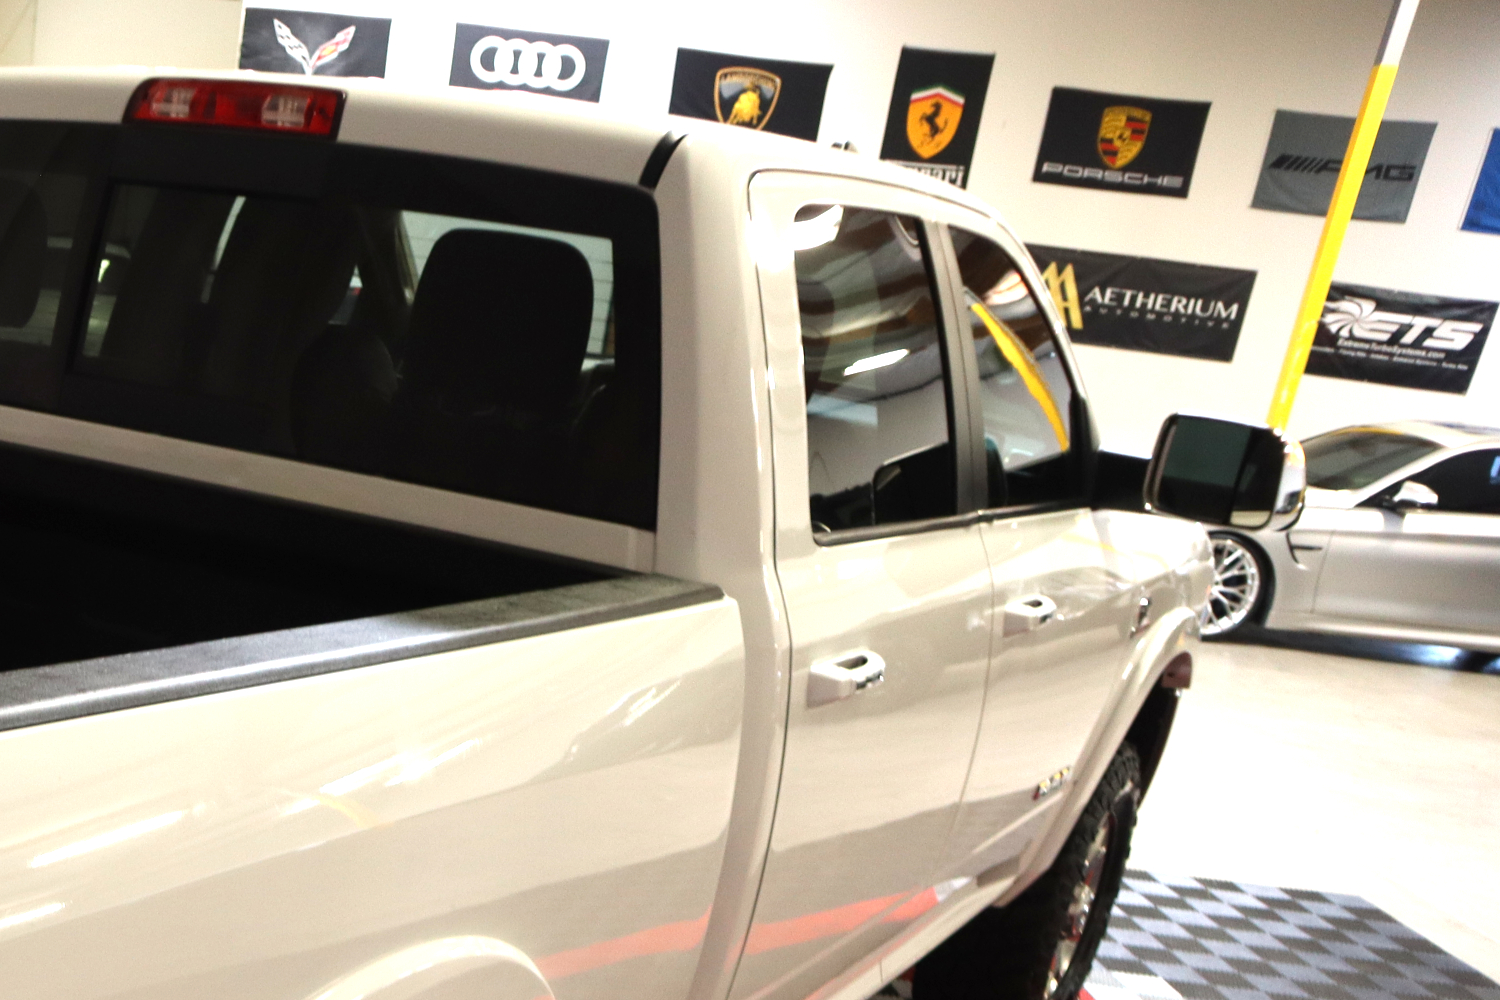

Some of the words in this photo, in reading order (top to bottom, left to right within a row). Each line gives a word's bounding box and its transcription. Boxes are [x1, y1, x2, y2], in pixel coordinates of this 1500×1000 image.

[1041, 161, 1184, 189] PORSCHE
[1083, 304, 1231, 330] AUTOMOTIVE
[1084, 285, 1240, 321] AETHERIUM
[1351, 309, 1484, 351] ETS
